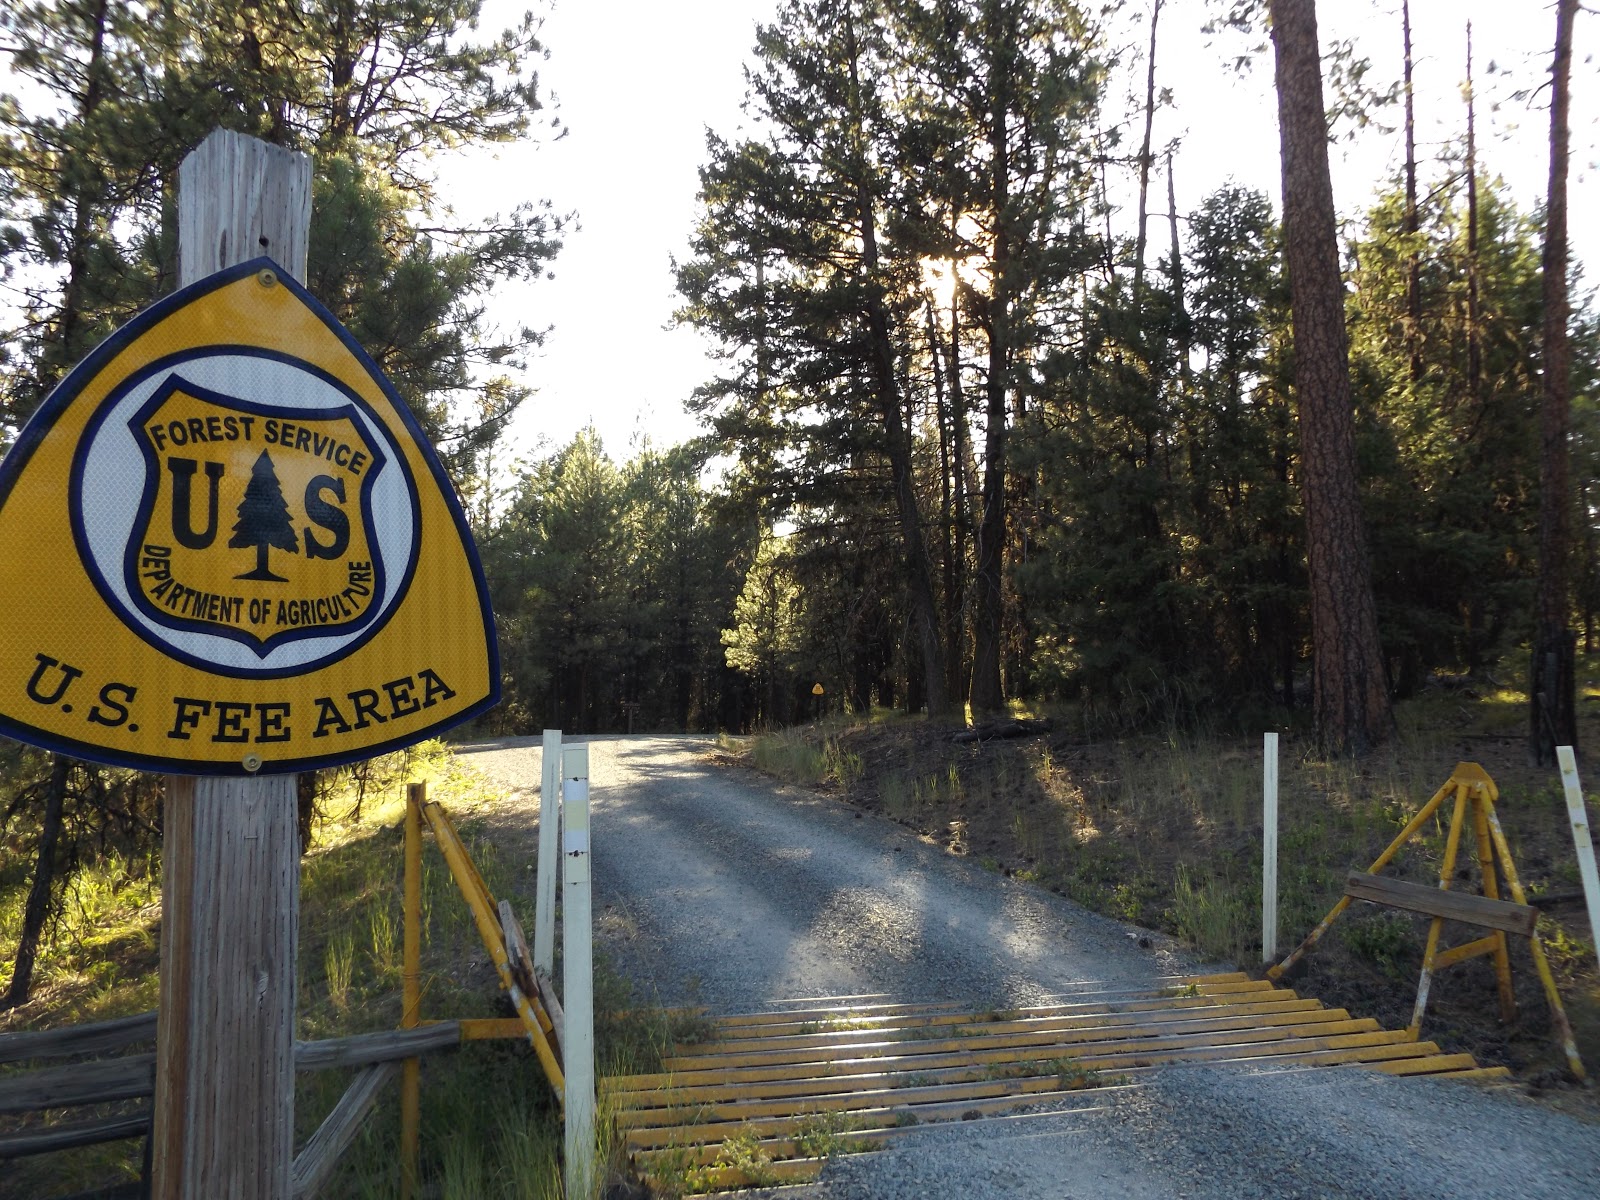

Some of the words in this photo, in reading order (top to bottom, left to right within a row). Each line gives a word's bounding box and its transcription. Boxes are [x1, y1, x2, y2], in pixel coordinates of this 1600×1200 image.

[150, 416, 254, 451] FOREST
[264, 420, 367, 475] SERVICE
[142, 544, 244, 624] DEPARTMENT
[249, 597, 272, 625] OF
[276, 561, 372, 625] AGRICULTURE
[26, 653, 139, 732] U.S.
[167, 697, 292, 743] FEE
[312, 668, 456, 738] AREA
